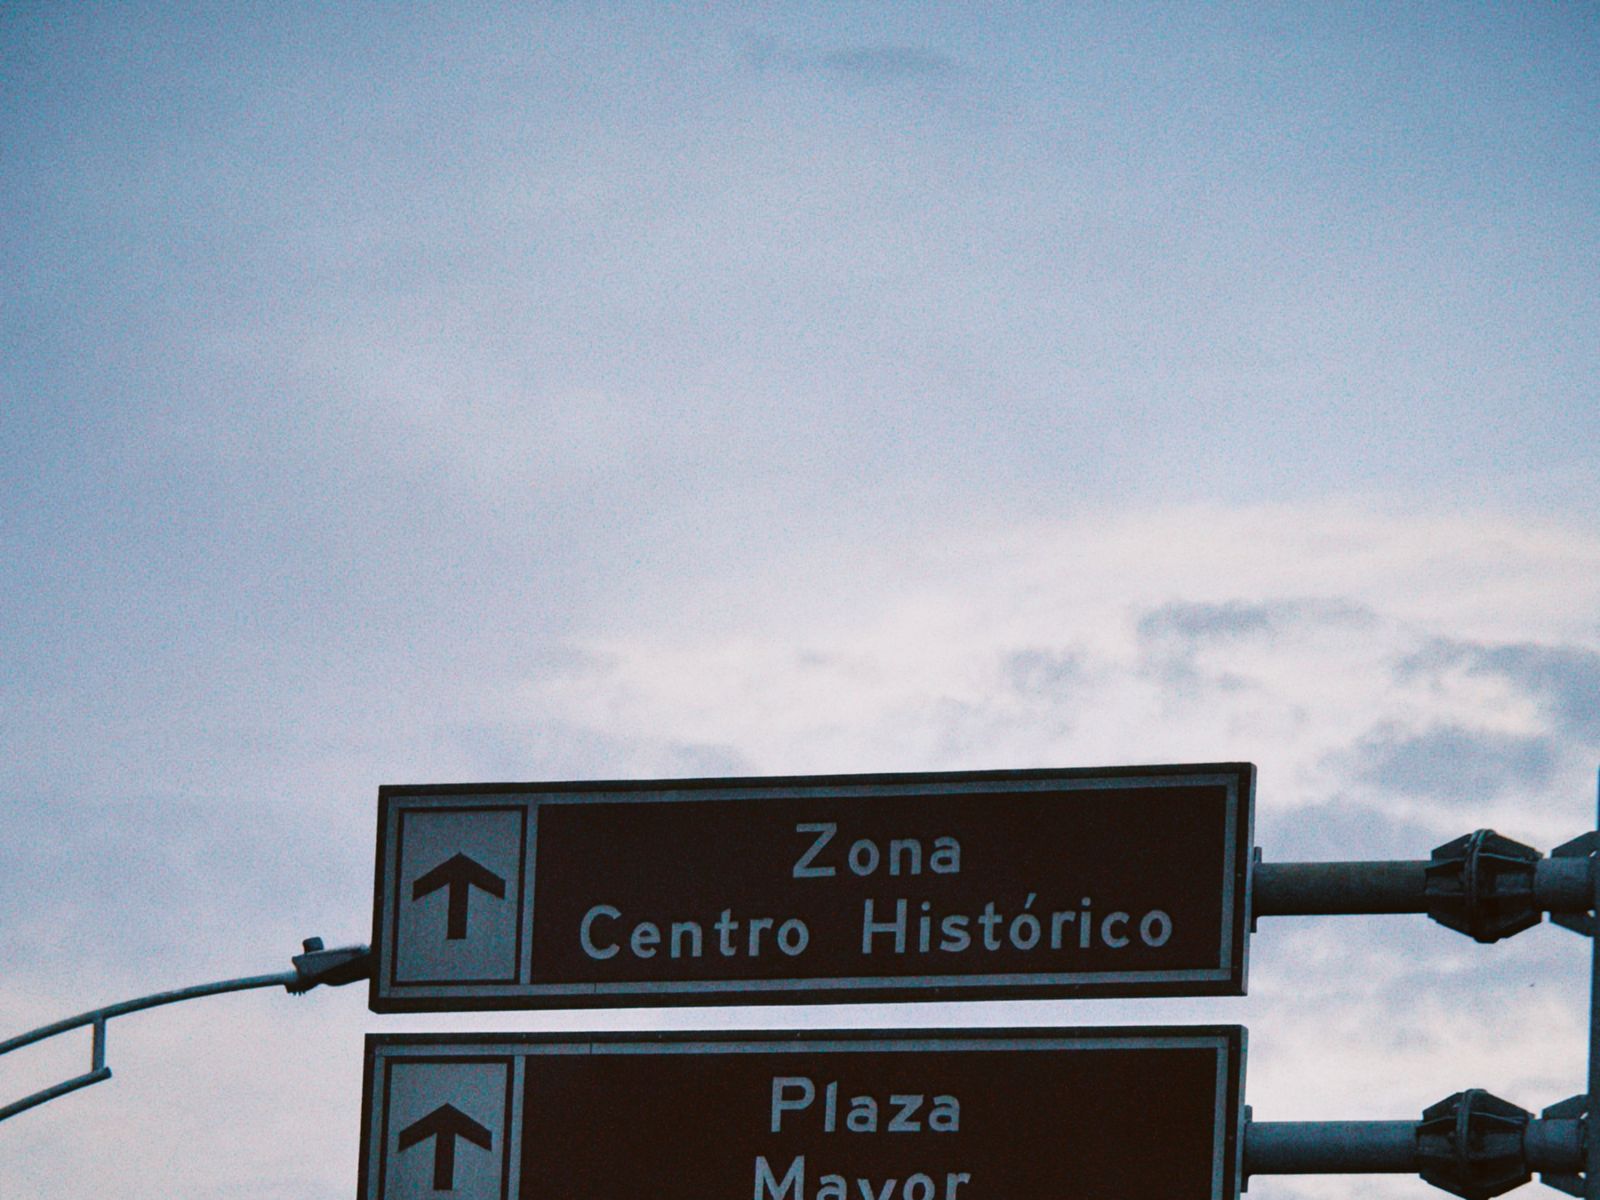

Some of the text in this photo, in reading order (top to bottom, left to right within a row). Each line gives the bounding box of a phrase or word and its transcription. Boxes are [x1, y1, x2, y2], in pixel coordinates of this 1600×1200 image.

[792, 822, 962, 878] Zona
[579, 893, 1174, 960] Centro Histórico
[770, 1076, 962, 1133] Plaza
